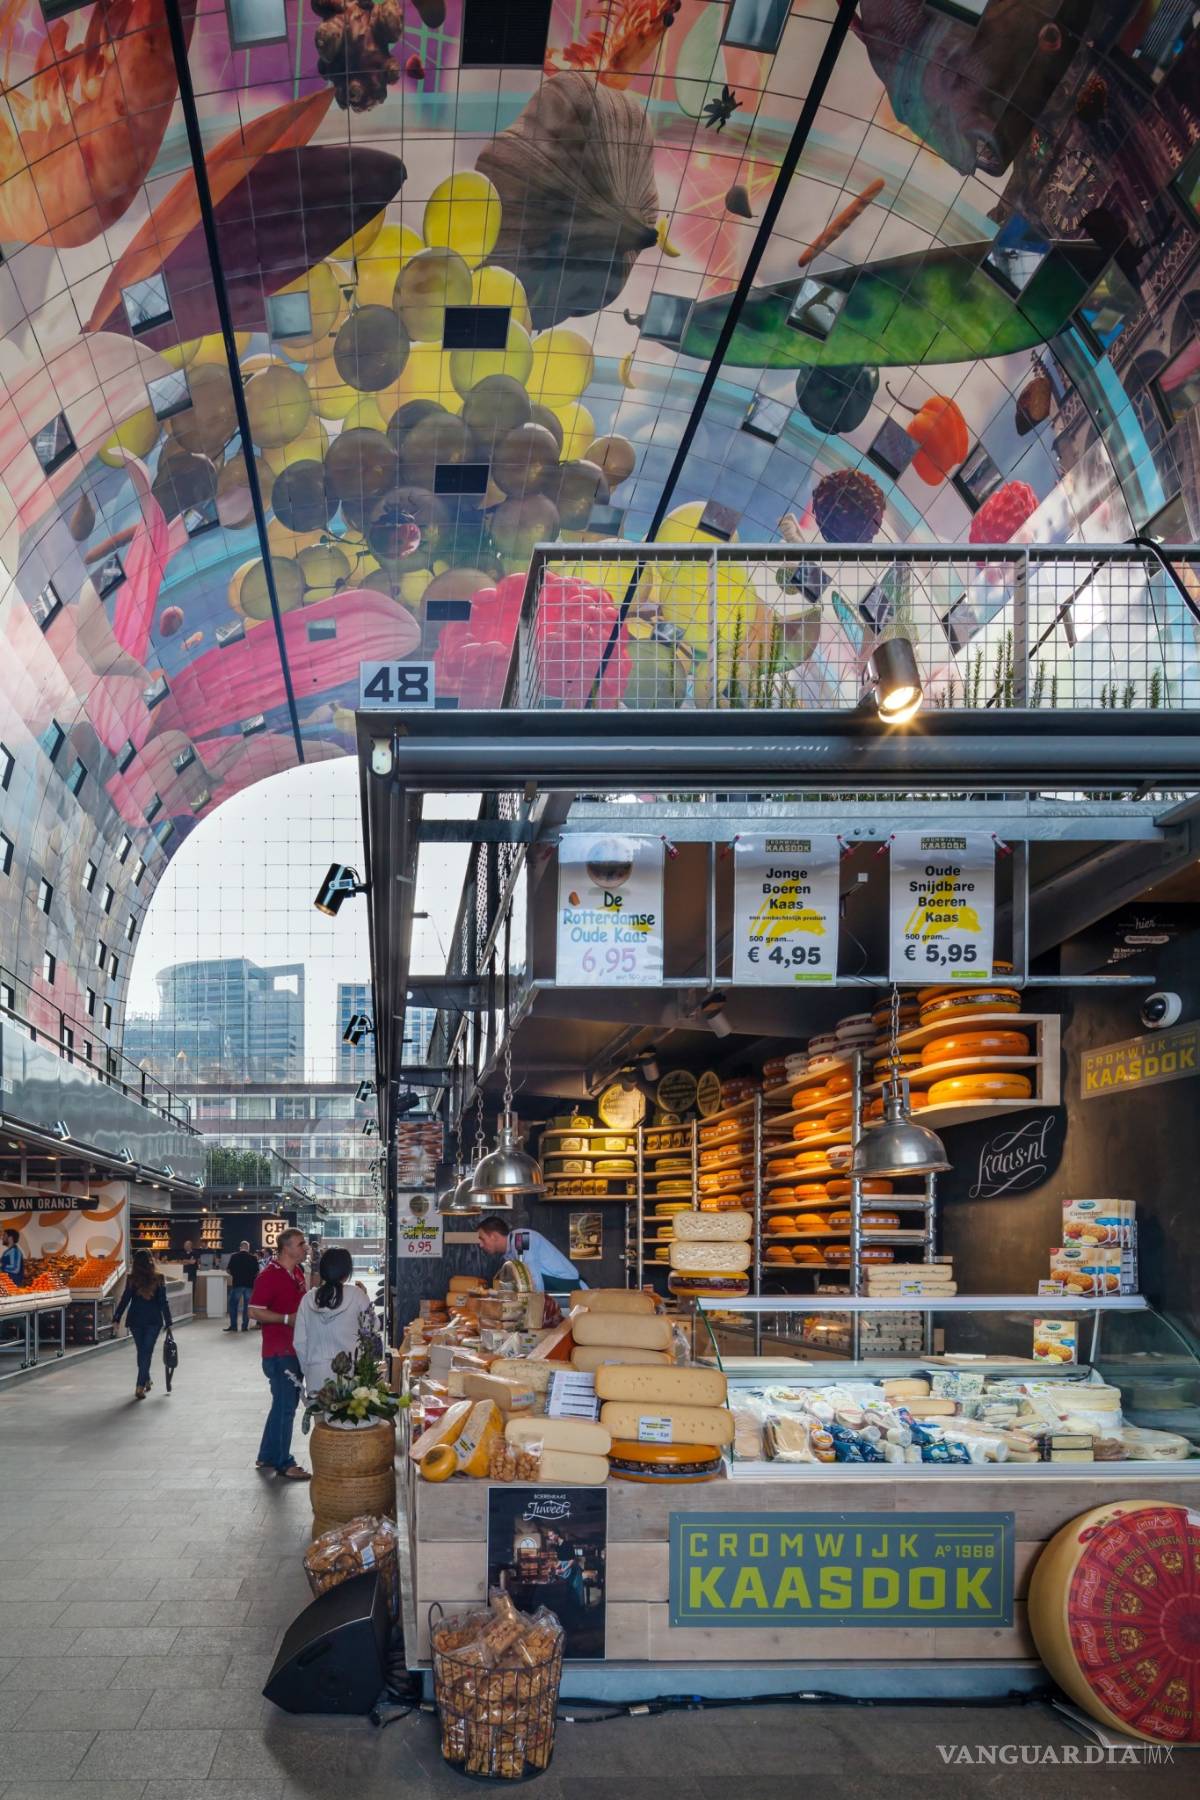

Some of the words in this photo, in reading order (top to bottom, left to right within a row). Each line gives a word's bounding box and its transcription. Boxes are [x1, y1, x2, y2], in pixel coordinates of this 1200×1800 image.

[364, 667, 429, 702] 48
[766, 868, 808, 881] Jonge
[925, 865, 961, 876] Oude
[762, 883, 811, 894] Boeren
[909, 881, 975, 894] Snijdbare
[604, 891, 623, 907] De
[769, 899, 804, 910] Kaas
[918, 896, 967, 907] Boeren
[563, 908, 656, 925] Rotterdamse
[925, 912, 959, 923] Kaas
[571, 927, 608, 943] Oude
[614, 927, 648, 943] Kaas
[582, 947, 636, 976] 6,95
[748, 946, 760, 963] €
[768, 946, 821, 968] 4,95
[904, 944, 916, 961] €
[926, 944, 977, 966] 5,95
[1087, 1040, 1166, 1070] CROMWIJK
[1087, 1048, 1195, 1090] KAASDOK
[12, 1198, 32, 1210] VAN
[38, 1197, 78, 1209] ORANJE
[408, 1241, 432, 1254] 6,95
[689, 1533, 918, 1559] CROMWIJK
[689, 1566, 993, 1609] KAASDOK
